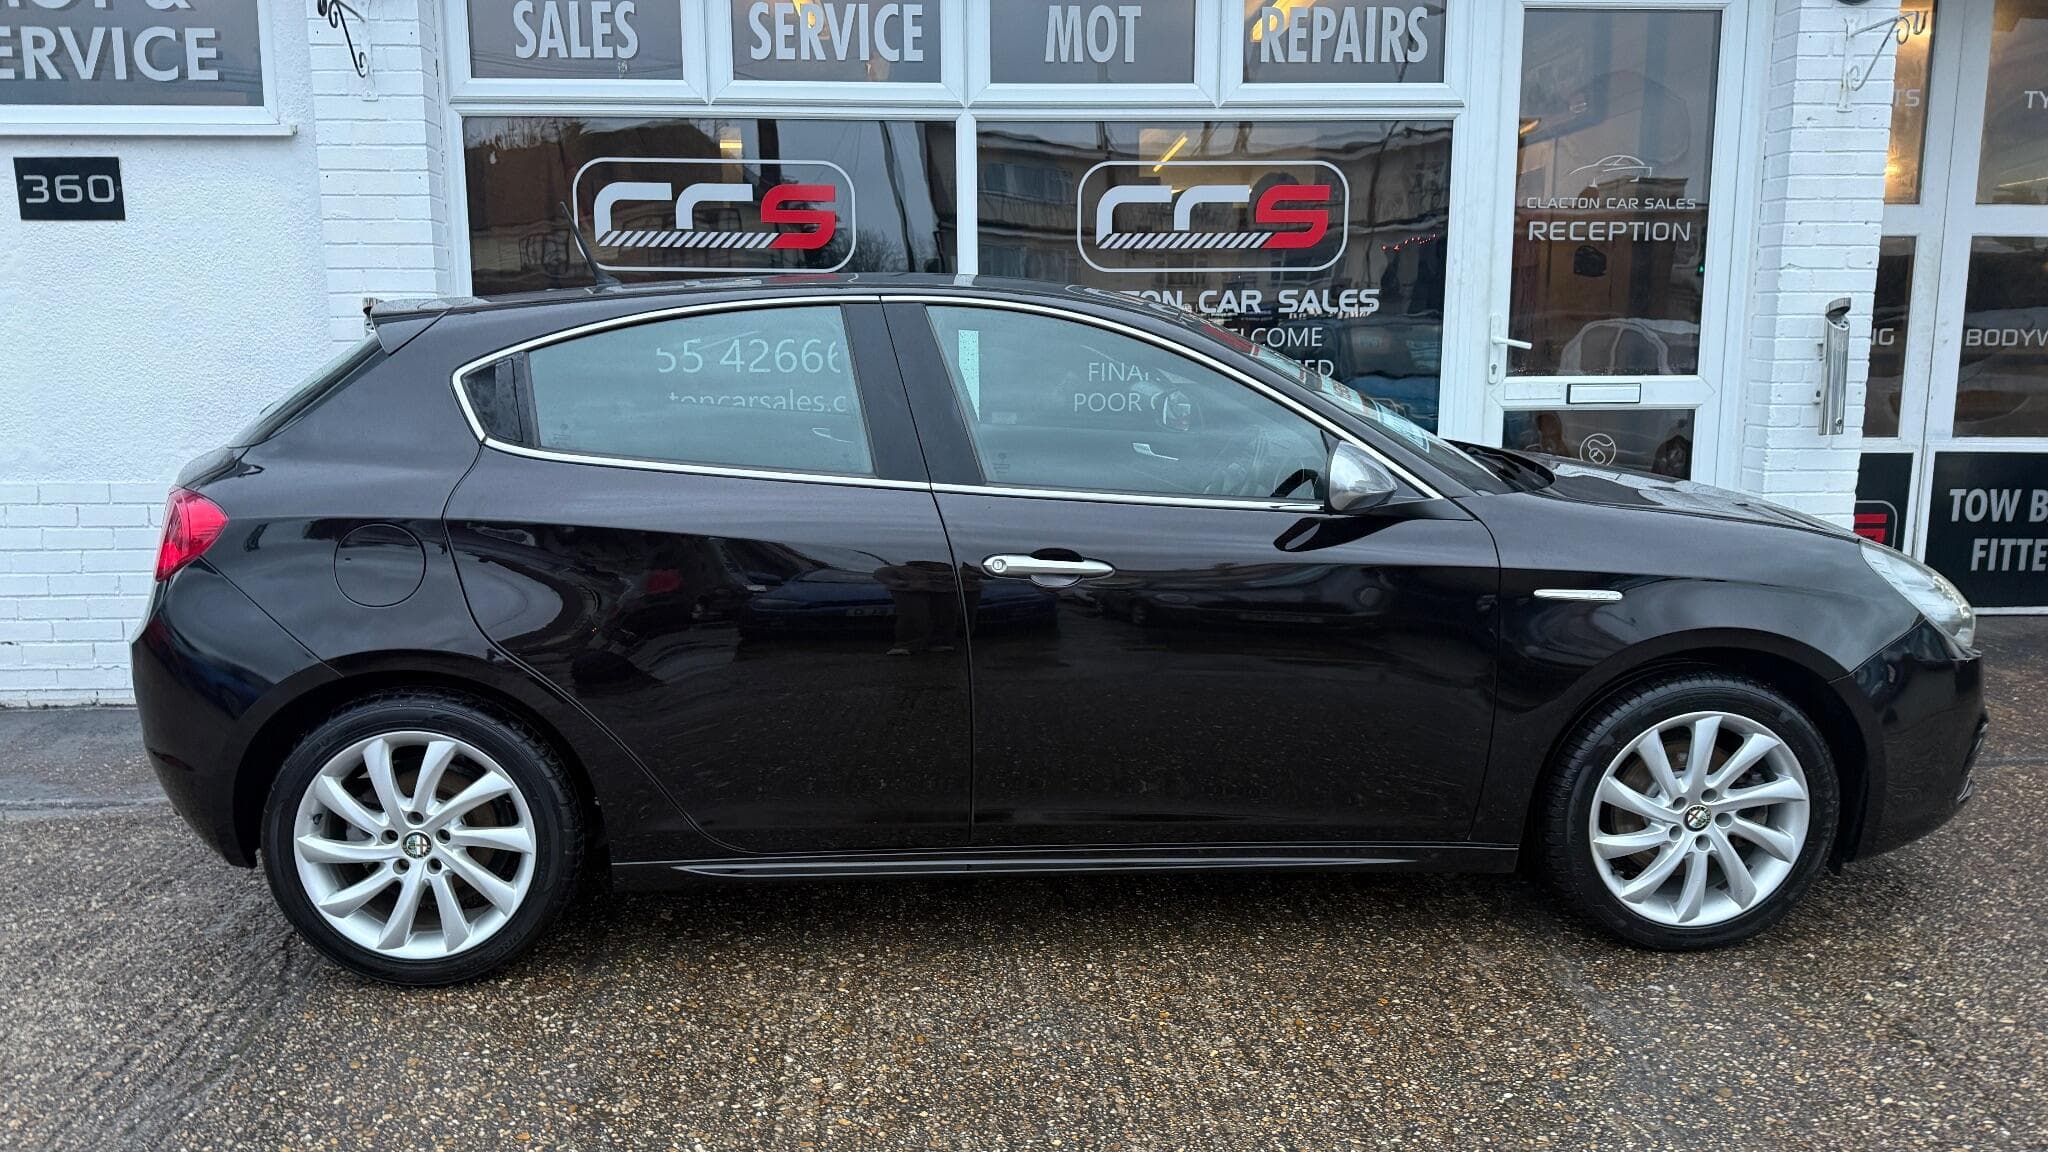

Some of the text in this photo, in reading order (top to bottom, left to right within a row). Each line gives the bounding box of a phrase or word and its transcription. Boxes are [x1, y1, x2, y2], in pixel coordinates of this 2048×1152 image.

[513, 0, 638, 58] SALES
[749, 2, 924, 62] SERVICE
[1044, 5, 1141, 63] MOT
[1259, 6, 1429, 63] REPAIRS
[23, 174, 115, 204] 360
[1527, 197, 1696, 210] CLACTON CAR SALES
[1528, 221, 1691, 241] RECEPTION
[1199, 290, 1262, 314] CAR
[1278, 289, 1380, 314] SALES
[1073, 392, 1142, 412] POOR
[1949, 488, 2022, 522] TOW
[1970, 538, 2048, 571] FITTE
